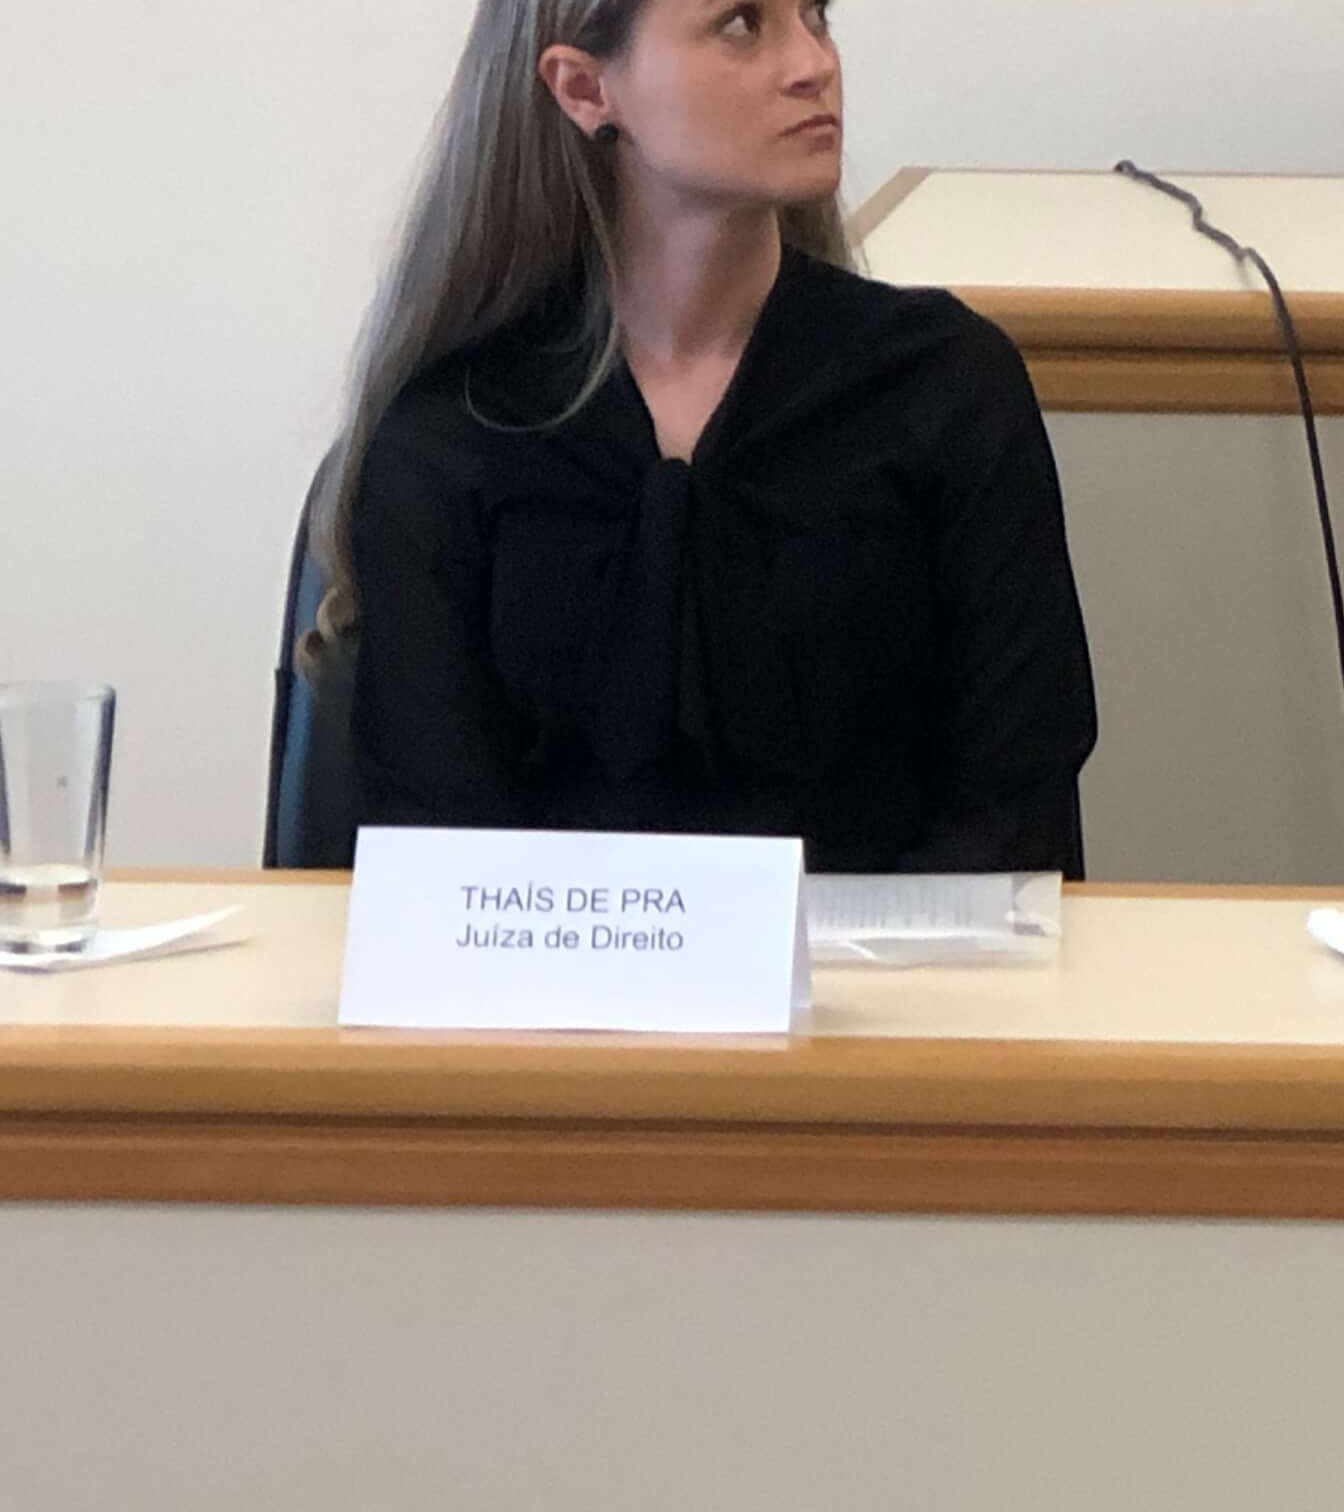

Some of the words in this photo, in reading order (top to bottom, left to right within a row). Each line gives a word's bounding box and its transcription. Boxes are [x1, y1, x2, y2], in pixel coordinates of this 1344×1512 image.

[461, 882, 554, 913] THAÍS
[567, 887, 609, 914] DE
[621, 888, 686, 914] PRA
[543, 925, 581, 950] de
[591, 925, 684, 952] Direito
